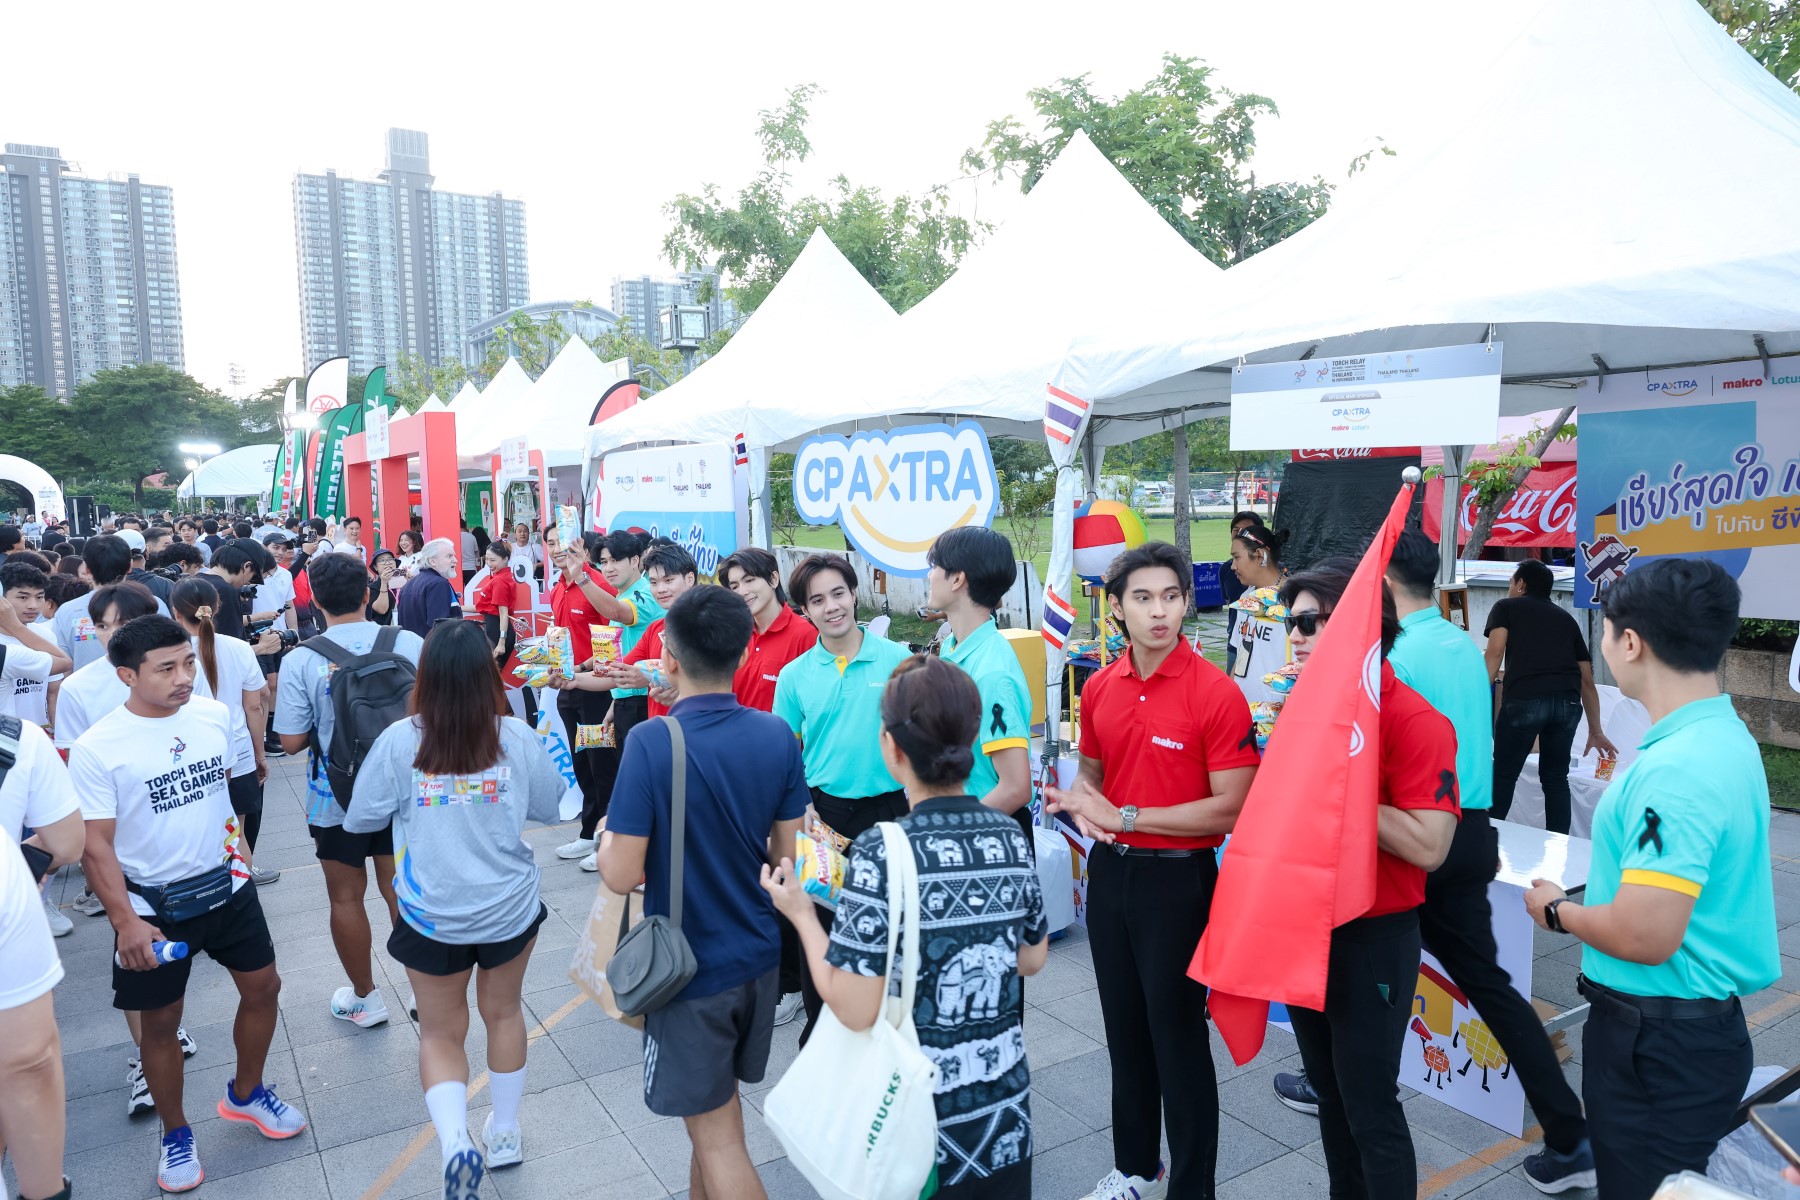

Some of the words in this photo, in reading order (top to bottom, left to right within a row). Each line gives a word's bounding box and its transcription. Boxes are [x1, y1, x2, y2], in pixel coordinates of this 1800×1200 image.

[1647, 383, 1660, 392] CP
[1661, 379, 1698, 391] AXTRA
[1722, 377, 1763, 390] makro
[1332, 408, 1343, 417] CP
[1343, 407, 1371, 416] AXTRA
[1331, 424, 1350, 432] makro
[804, 457, 844, 502] CP
[848, 448, 982, 502] AXTRA
[1620, 446, 1769, 531] เชียร์สุดใจ
[1716, 514, 1765, 535] ไปกับ
[1151, 735, 1184, 750] makro
[145, 767, 187, 791] TORCH
[188, 755, 223, 775] RELAY
[150, 785, 178, 804] SEA
[180, 767, 225, 791] GAMES
[152, 790, 204, 815] THAILAND
